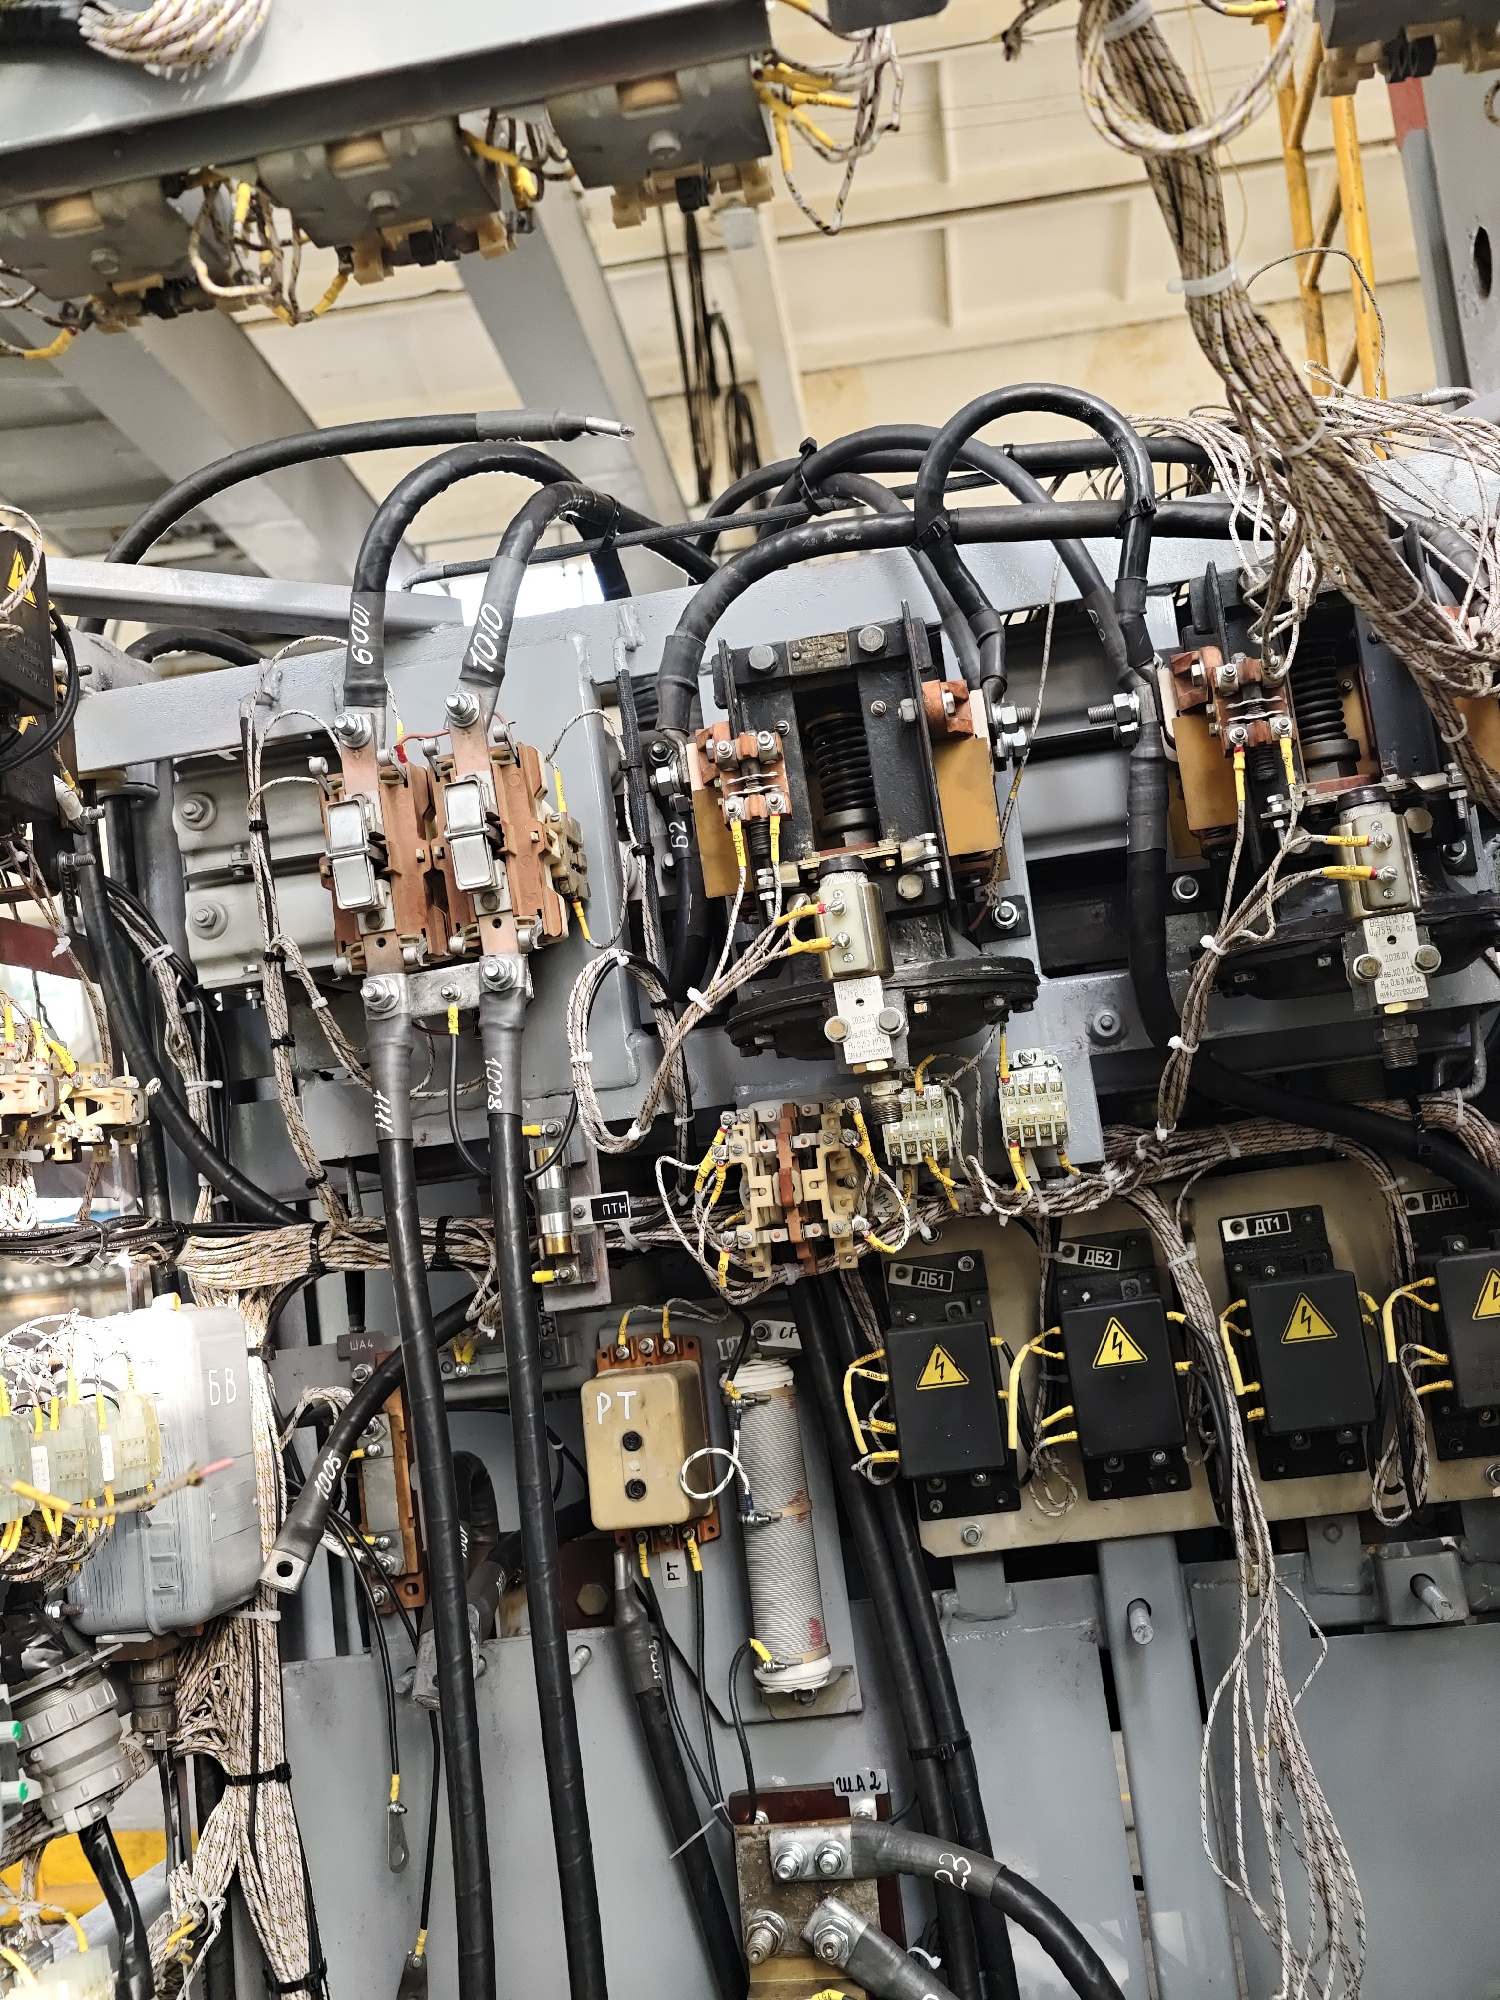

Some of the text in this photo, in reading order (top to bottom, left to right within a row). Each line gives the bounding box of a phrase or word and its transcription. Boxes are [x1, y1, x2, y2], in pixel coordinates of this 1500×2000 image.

[351, 602, 374, 665] 1009
[470, 603, 503, 672] 1010
[668, 821, 689, 849] Б2
[485, 1058, 502, 1110] 1008
[373, 1090, 394, 1133] 1111
[602, 1202, 627, 1216] ПТН
[1431, 1191, 1459, 1210] ДН1
[1255, 1217, 1280, 1235] ДТ1
[1083, 1249, 1113, 1266] ДБ2
[917, 1271, 944, 1288] ДБ1
[350, 1340, 374, 1351] ША4
[208, 1367, 238, 1407] БВ
[596, 1390, 638, 1425] РТ
[314, 1450, 342, 1500] 1005
[666, 1561, 681, 1582] РТ
[934, 1853, 972, 1891] 23
